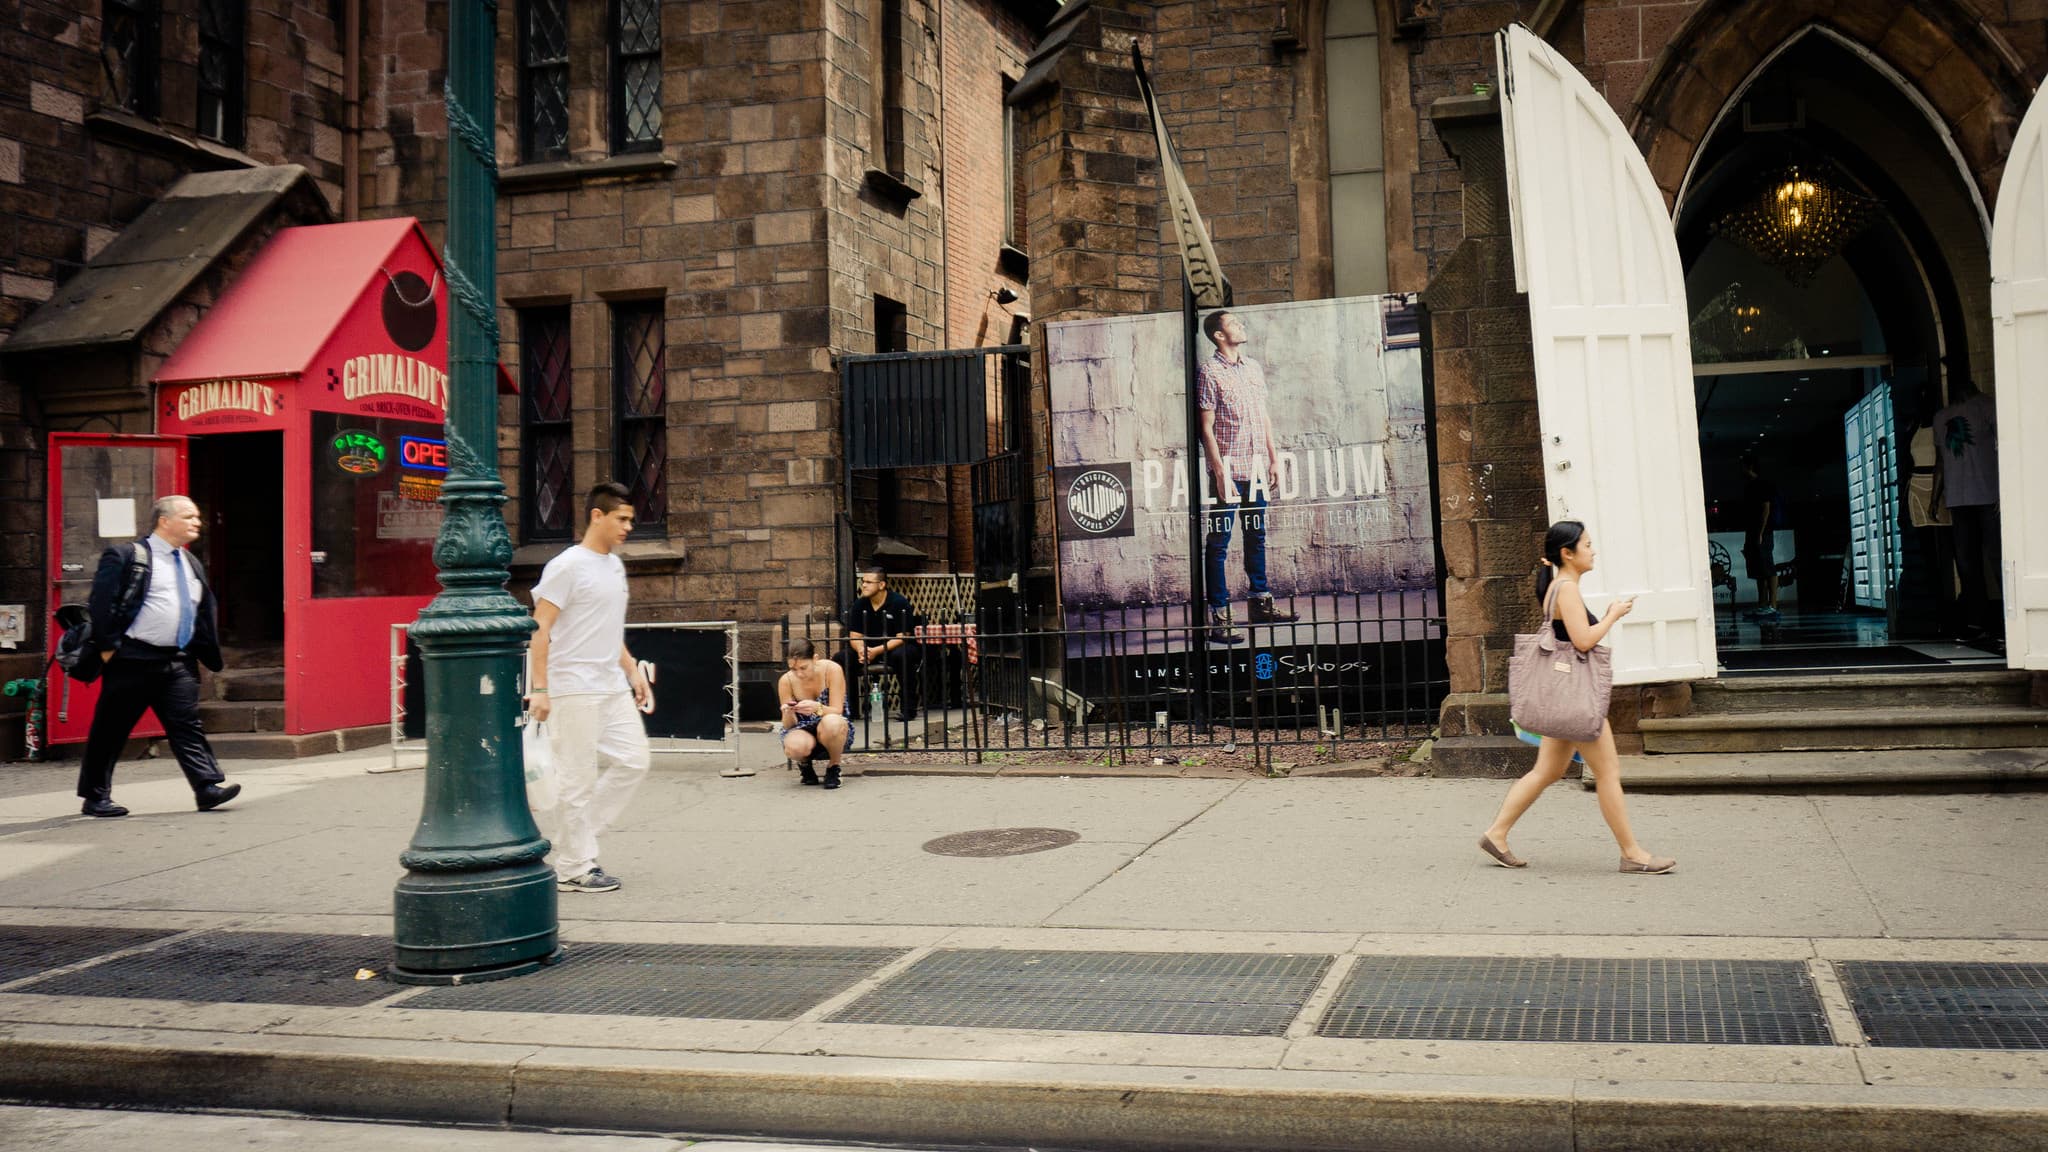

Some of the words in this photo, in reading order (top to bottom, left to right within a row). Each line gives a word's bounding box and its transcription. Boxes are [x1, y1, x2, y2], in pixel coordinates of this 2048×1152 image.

[343, 353, 449, 412] GRIMALDI'S
[178, 380, 274, 421] GRIMALDI'S
[334, 434, 386, 460] PIZZA
[403, 441, 448, 467] OPE
[1143, 445, 1387, 513] PALLADIUM
[1070, 483, 1125, 521] PALLADIUM
[1244, 513, 1270, 532] FOR
[1283, 510, 1316, 529] CITY
[1328, 506, 1390, 526] TERRAIN
[1134, 662, 1248, 680] LIMEGHT
